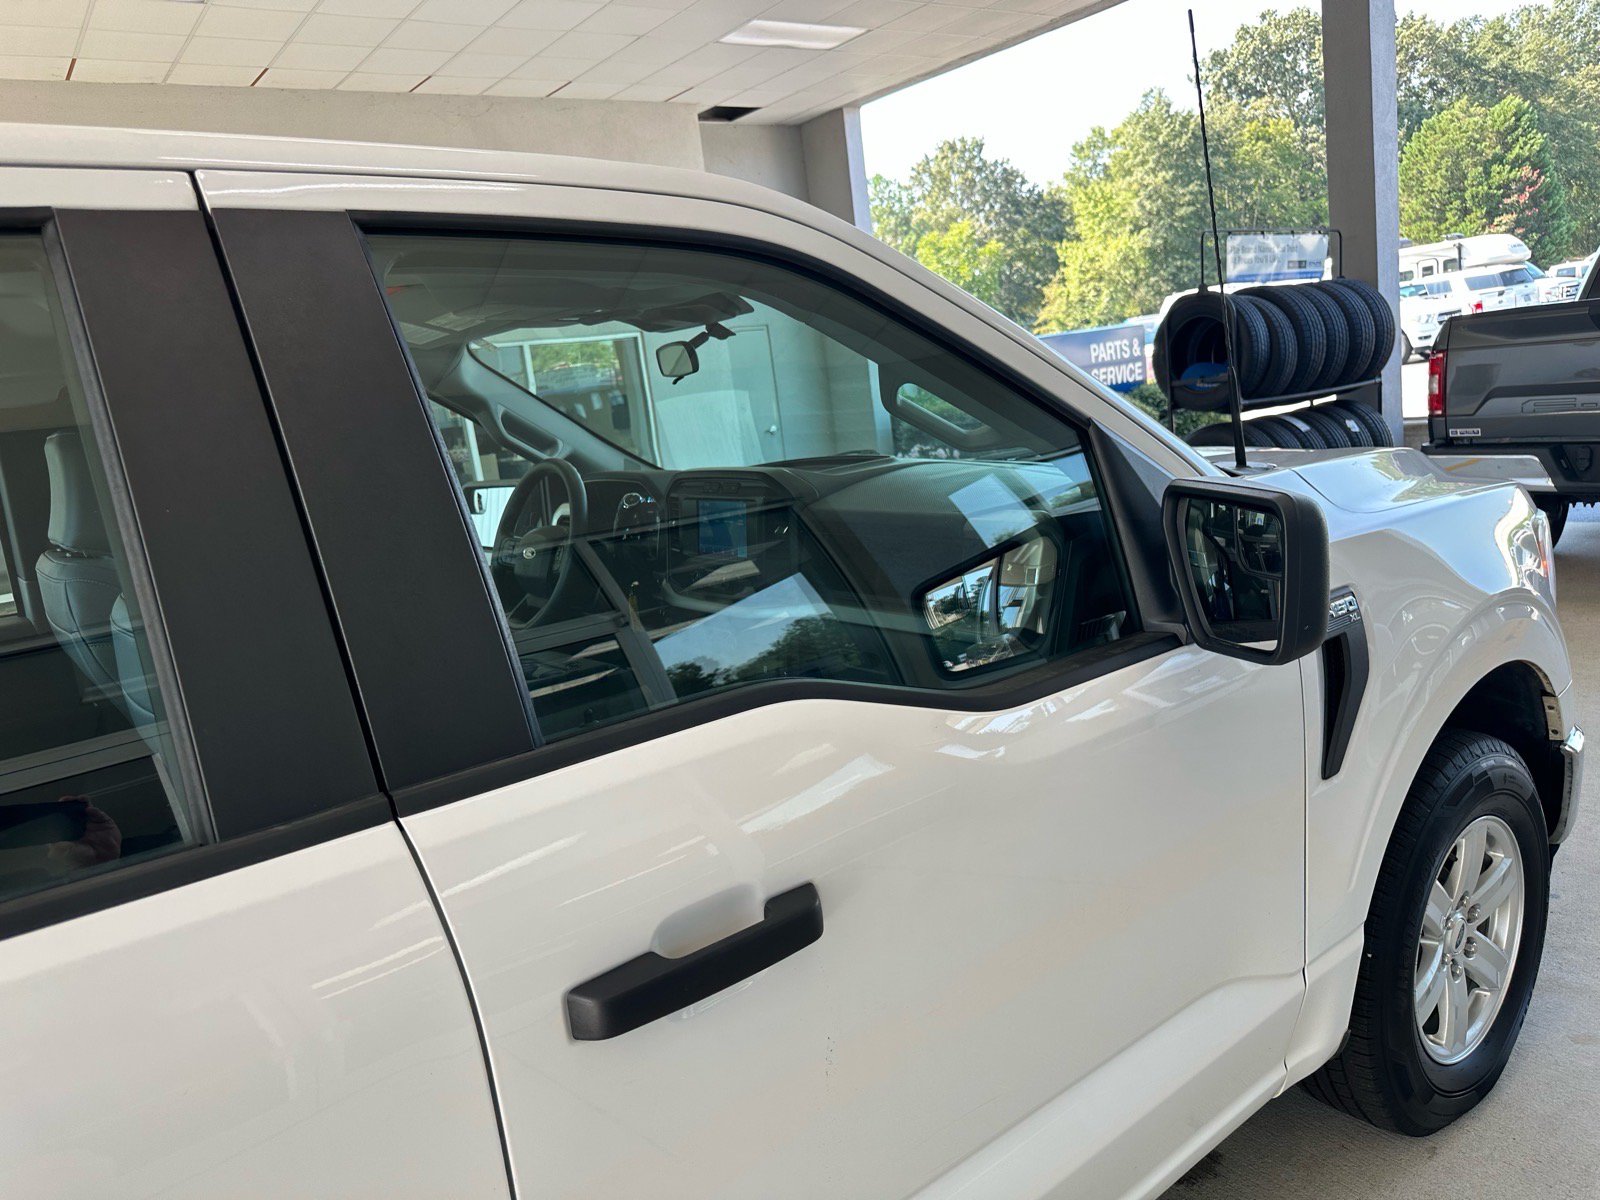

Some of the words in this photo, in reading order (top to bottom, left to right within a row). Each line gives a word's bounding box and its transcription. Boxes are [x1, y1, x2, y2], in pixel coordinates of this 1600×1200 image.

[1090, 339, 1130, 363] PARTS
[1132, 338, 1142, 357] &
[1091, 361, 1143, 386] SERVICE
